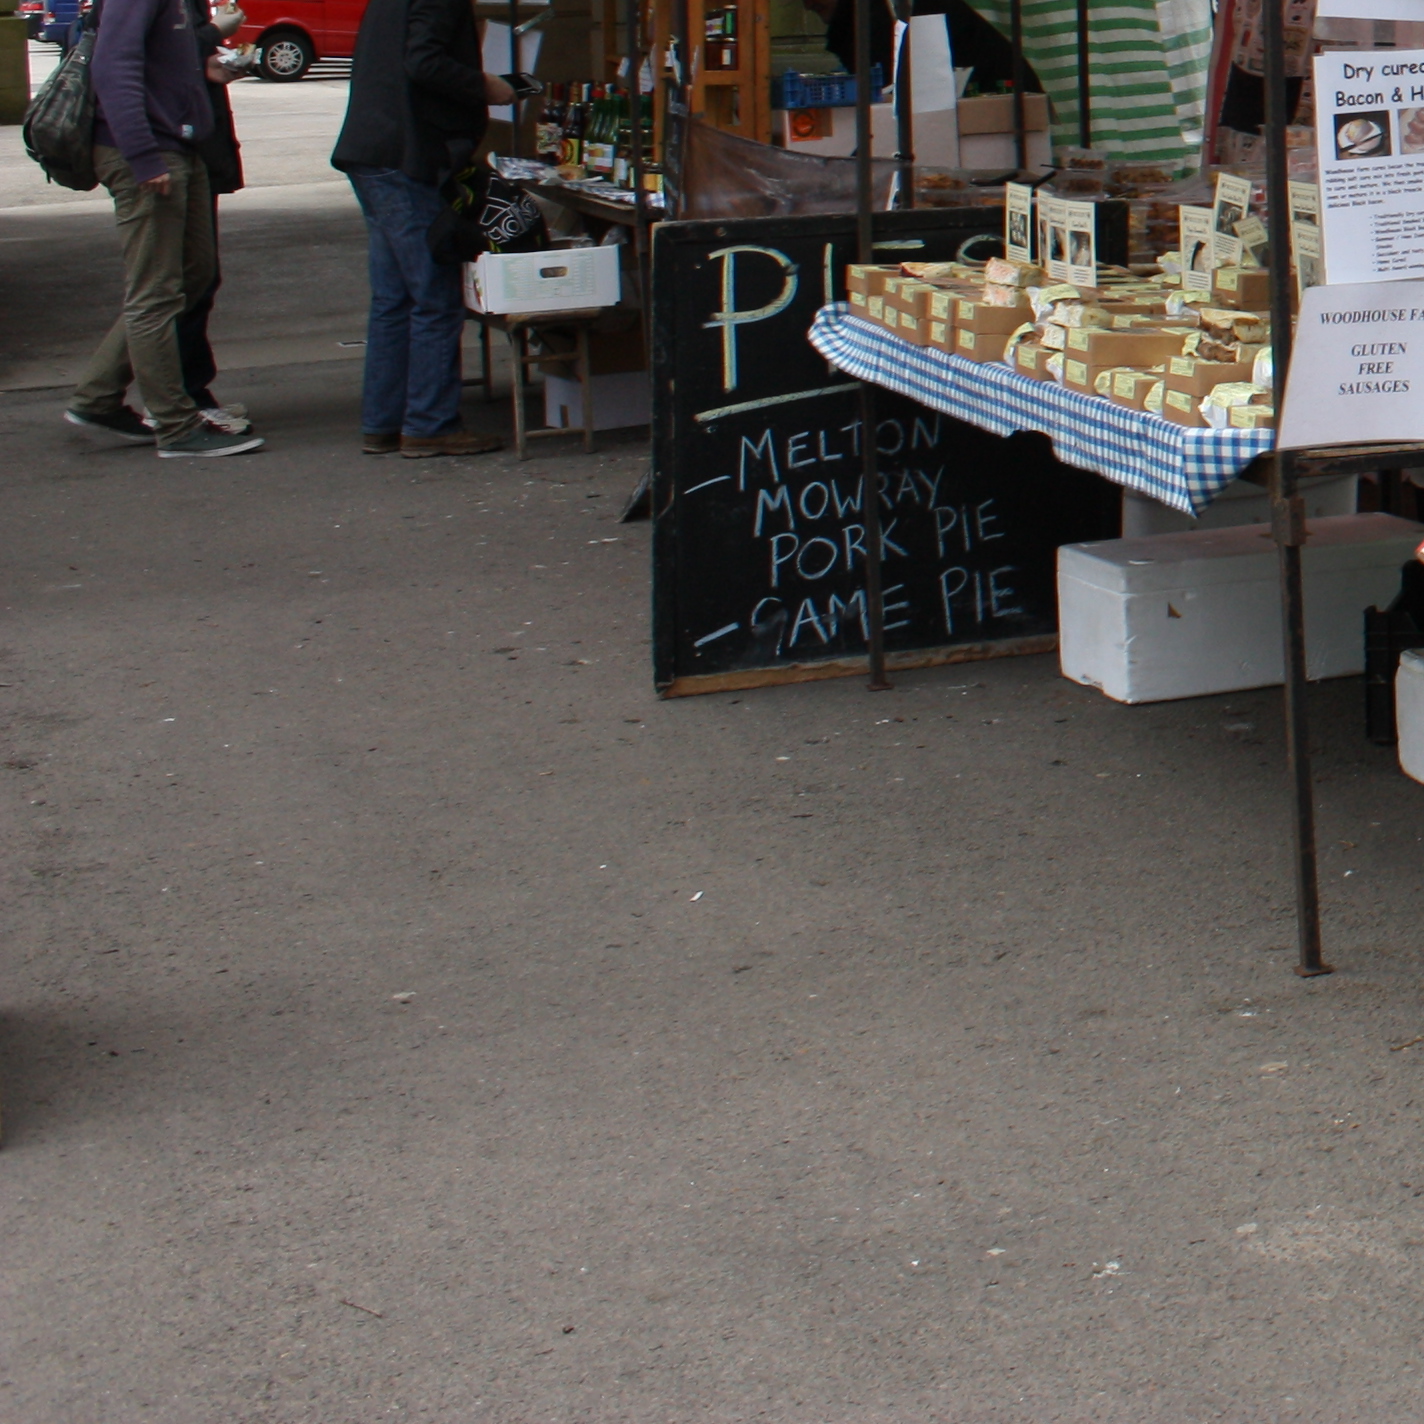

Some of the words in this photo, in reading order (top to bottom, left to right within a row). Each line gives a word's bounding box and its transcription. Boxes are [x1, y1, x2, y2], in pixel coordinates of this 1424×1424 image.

[1343, 63, 1373, 82] Dry
[1336, 90, 1384, 107] Bacon
[1391, 88, 1403, 103] &
[1320, 309, 1406, 324] WOODHOUSE
[1351, 342, 1407, 357] GLUTEN
[1358, 362, 1394, 375] FREE
[1338, 380, 1410, 395] SAUSAGES
[739, 418, 942, 491] MELTON
[770, 518, 908, 587] PORK
[936, 498, 1004, 558] PIE
[751, 584, 910, 657] GAME
[940, 566, 1022, 635] PIE
